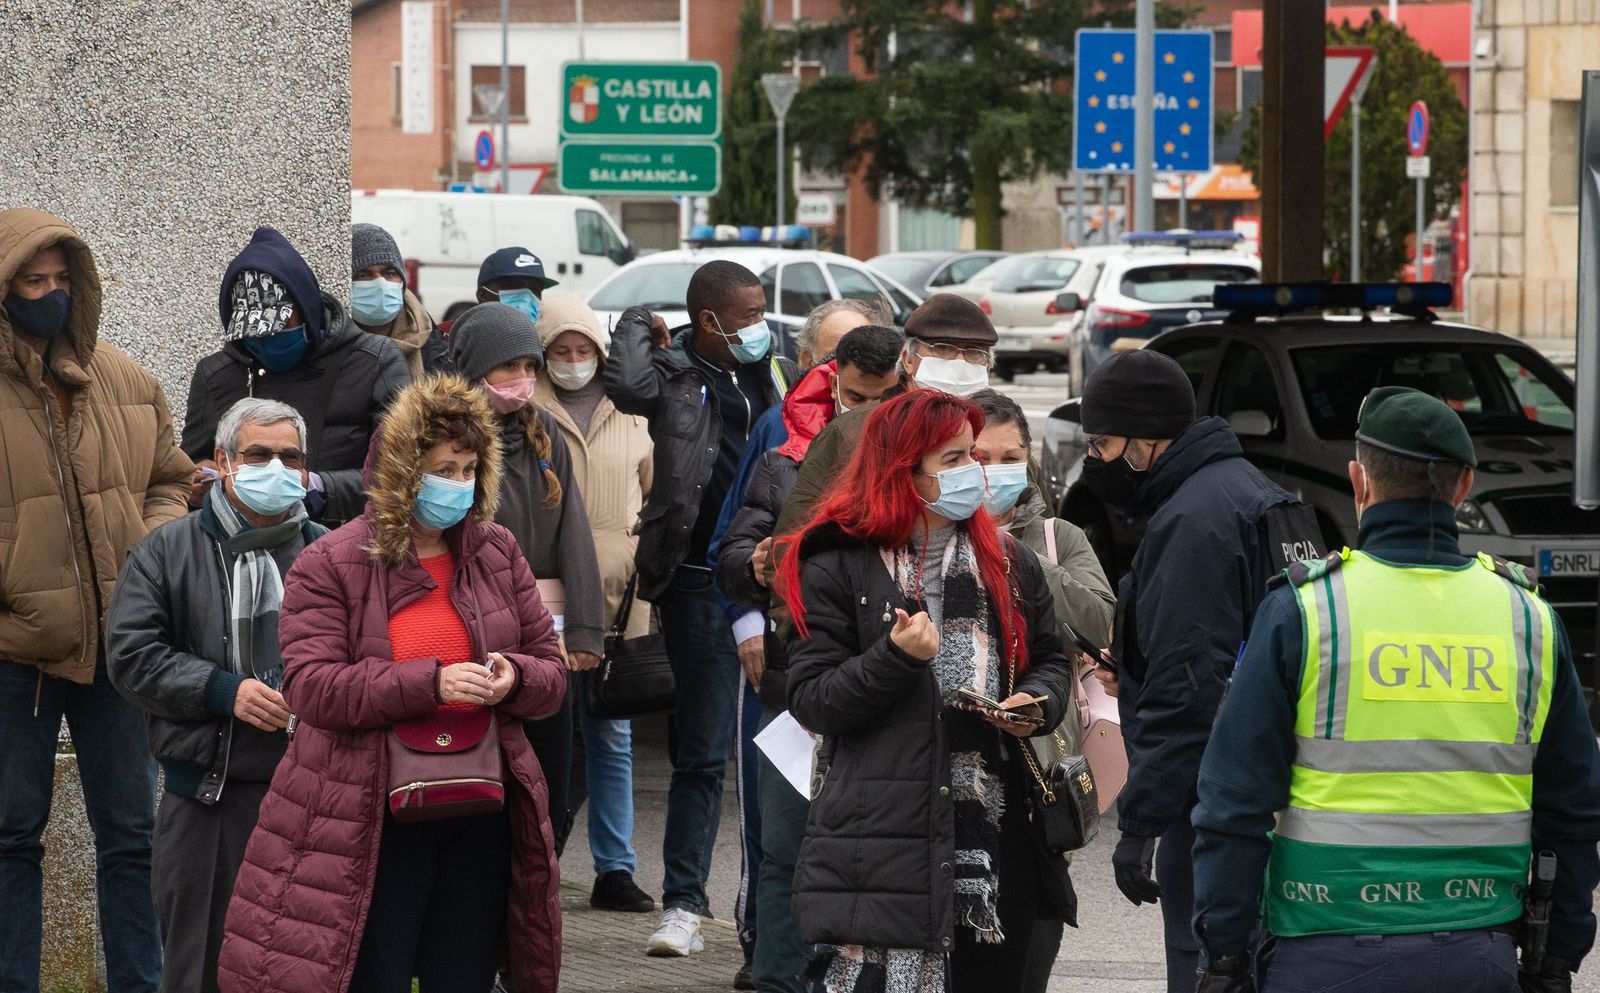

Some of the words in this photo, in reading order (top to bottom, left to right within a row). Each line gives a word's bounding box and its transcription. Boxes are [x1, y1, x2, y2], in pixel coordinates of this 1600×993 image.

[604, 79, 712, 98] CASTILLA
[1107, 92, 1179, 110] ESÑA
[616, 104, 630, 123] Y
[640, 99, 703, 123] LEÓN
[589, 168, 688, 183] SALAMANCA
[1477, 460, 1573, 474] GN
[1368, 643, 1503, 692] GNR
[1283, 880, 1334, 904] GNR
[1360, 881, 1424, 903] GNR
[1444, 878, 1498, 898] GNR
